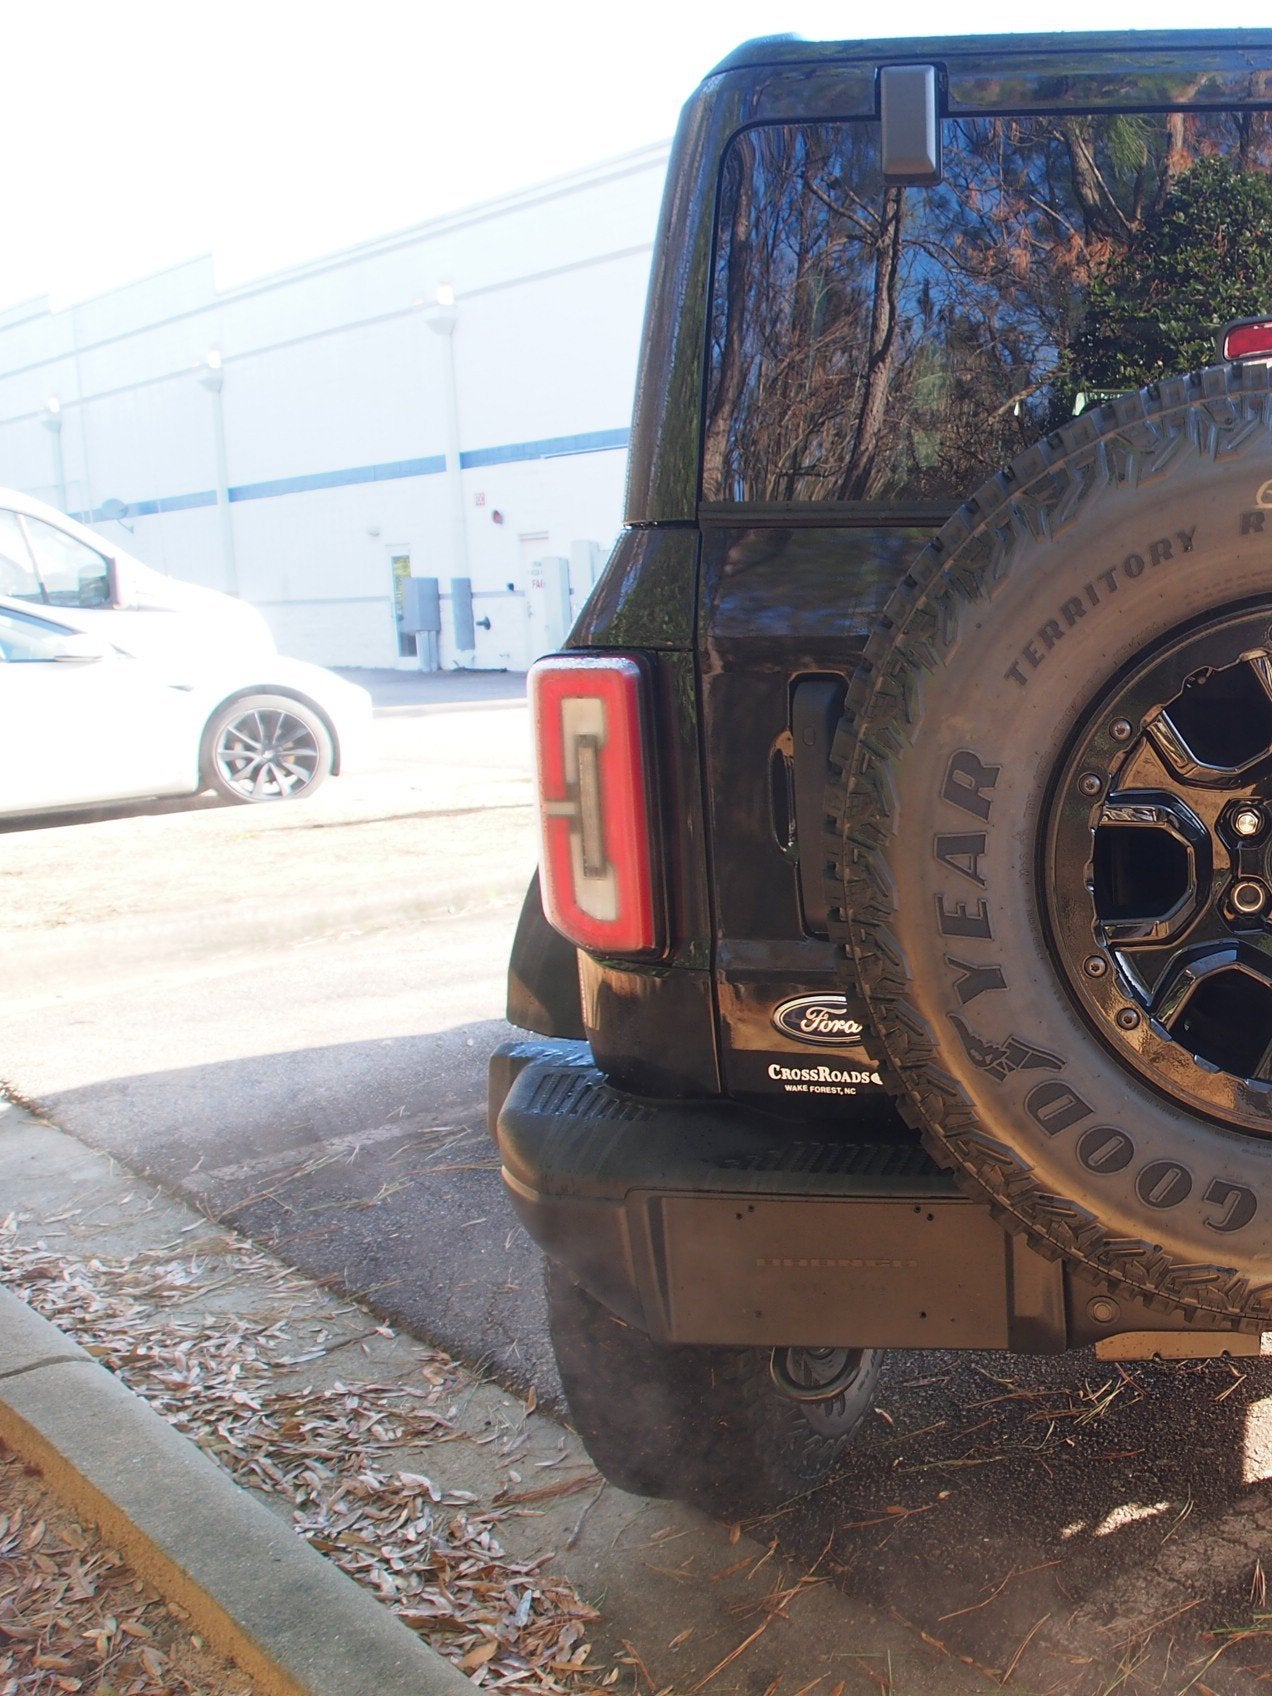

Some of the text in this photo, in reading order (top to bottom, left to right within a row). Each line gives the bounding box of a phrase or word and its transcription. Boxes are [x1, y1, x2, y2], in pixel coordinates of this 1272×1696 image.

[1003, 525, 1198, 688] TERRITORY
[784, 1084, 857, 1095] WAKE FOREST, NC
